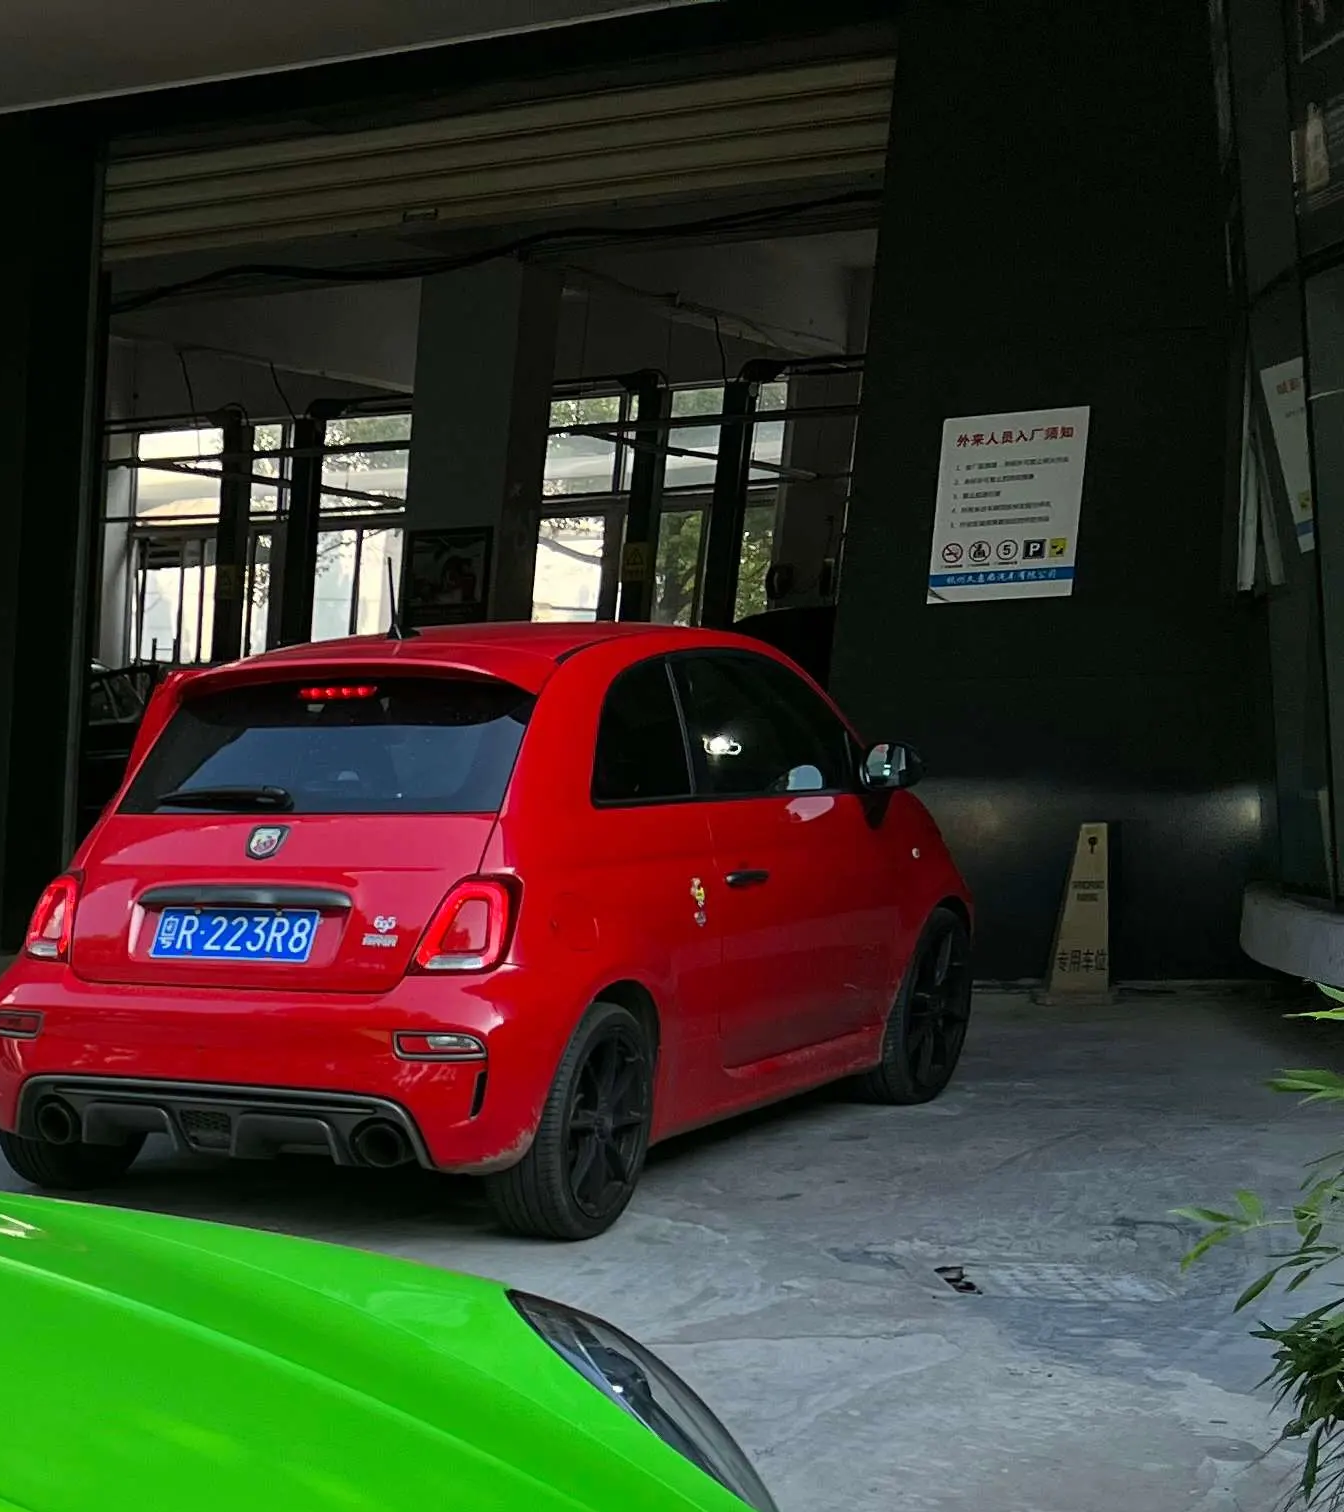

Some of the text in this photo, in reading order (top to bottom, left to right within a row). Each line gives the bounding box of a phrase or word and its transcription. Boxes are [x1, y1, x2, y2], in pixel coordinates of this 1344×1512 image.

[956, 426, 1074, 447] 外来人员入厂须知
